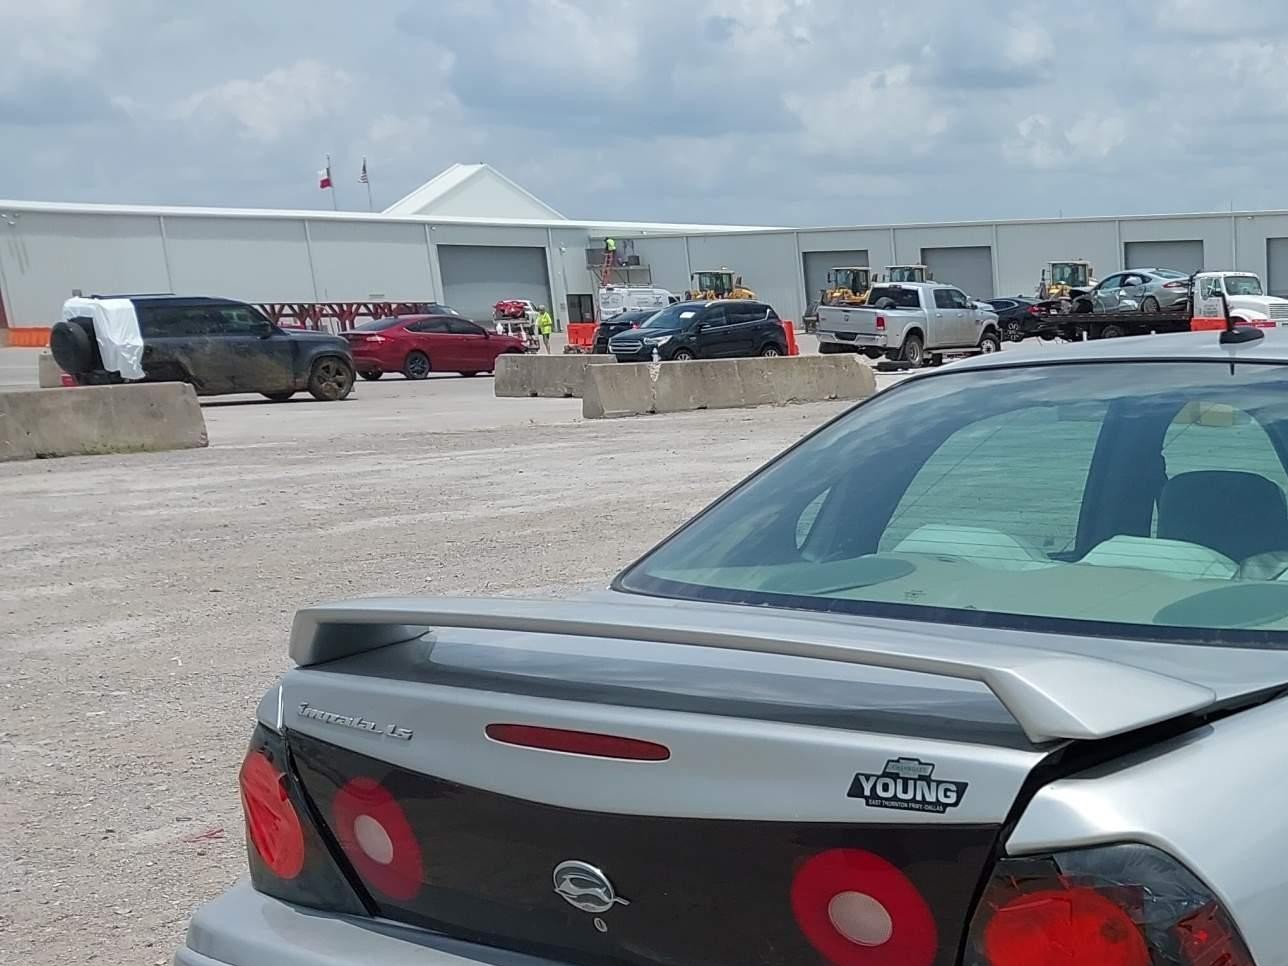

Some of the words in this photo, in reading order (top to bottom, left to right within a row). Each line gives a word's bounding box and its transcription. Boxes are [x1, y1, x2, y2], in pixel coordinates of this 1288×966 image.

[297, 701, 384, 734] Impala
[384, 723, 414, 741] LS
[858, 774, 958, 804] YOUNG
